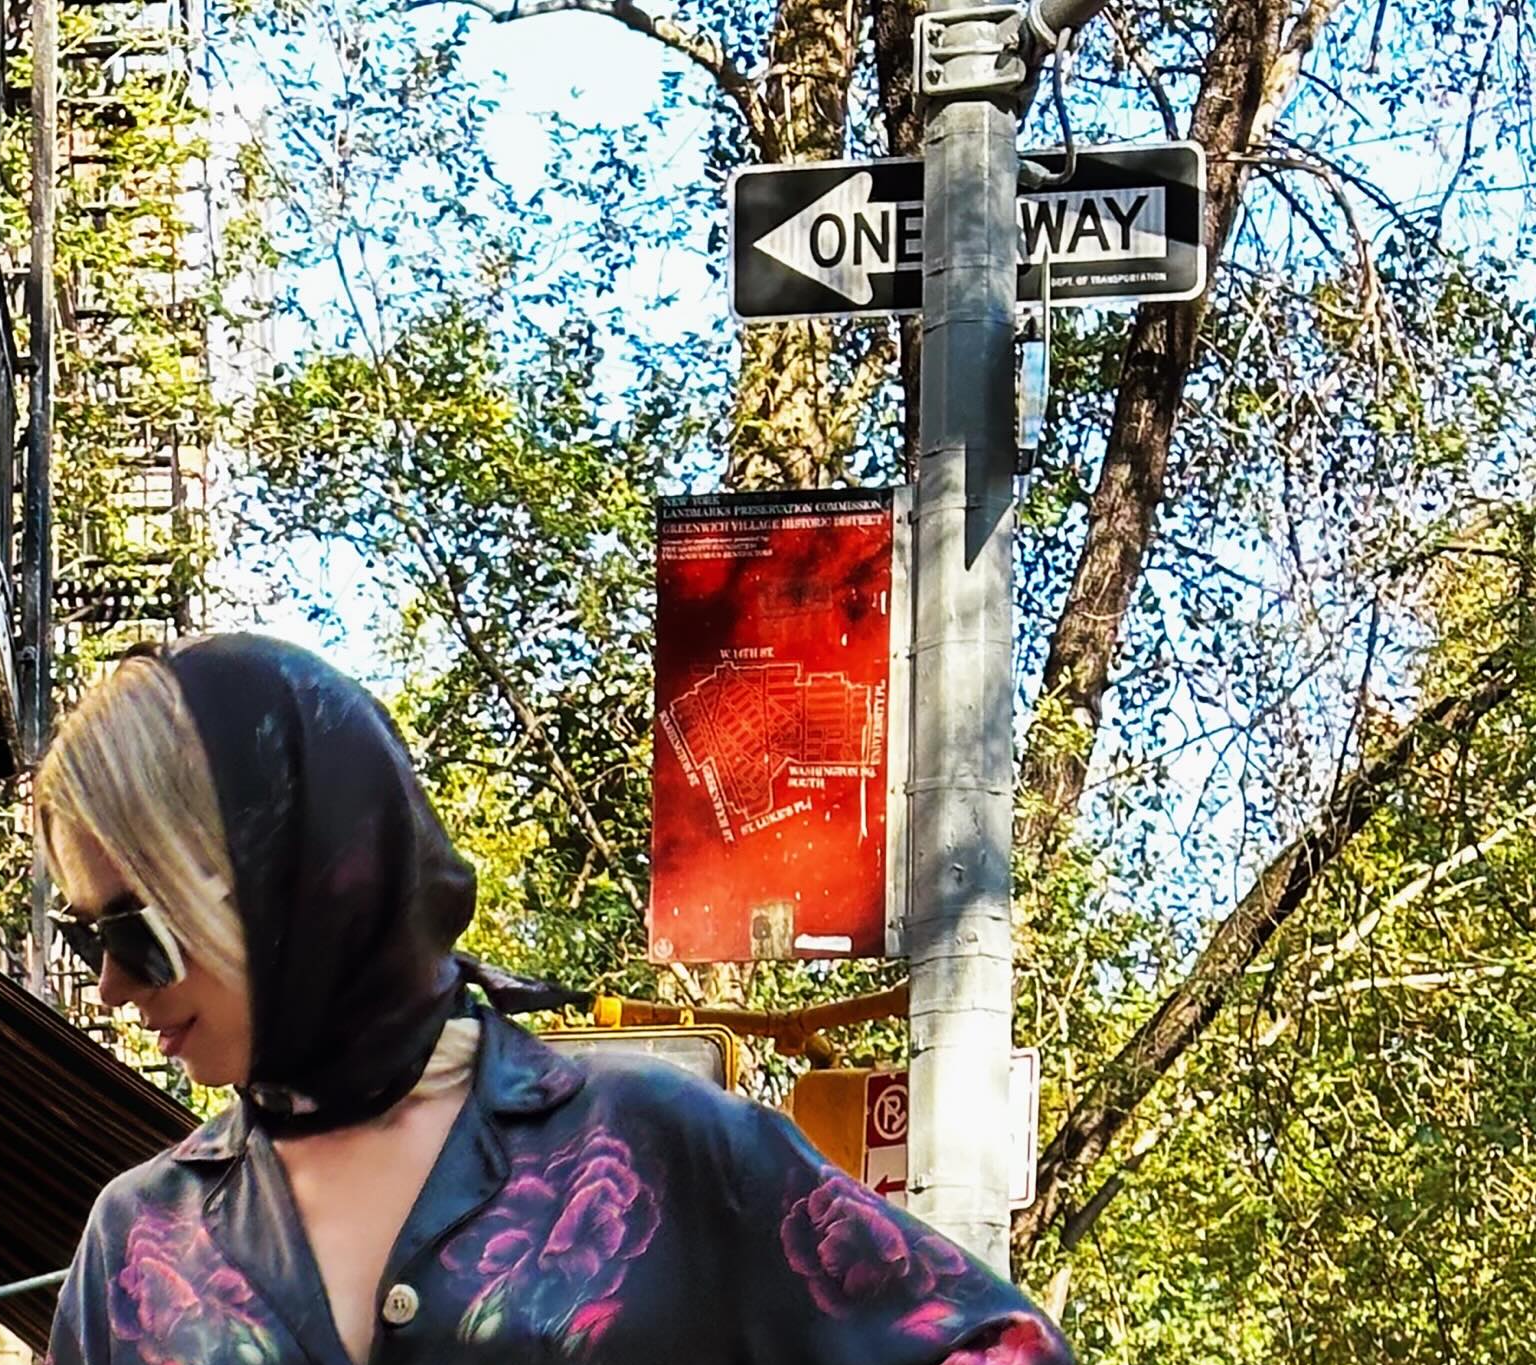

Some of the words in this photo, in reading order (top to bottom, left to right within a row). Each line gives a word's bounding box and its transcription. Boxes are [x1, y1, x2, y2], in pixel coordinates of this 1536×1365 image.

[810, 209, 924, 268] ONE
[1020, 194, 1149, 256] WAY
[1075, 275, 1089, 286] OF
[1090, 272, 1167, 285] TRANSPORTATION
[664, 506, 731, 519] LANDMARKS
[734, 503, 813, 516] PRESERVATION
[815, 500, 882, 512] COMMISSION
[662, 521, 729, 534] GREENWICH
[731, 518, 779, 532] VILLAGE
[781, 517, 832, 529] HISTORIC
[834, 514, 884, 527] DISTRICT
[788, 766, 859, 777] WASHINGTON
